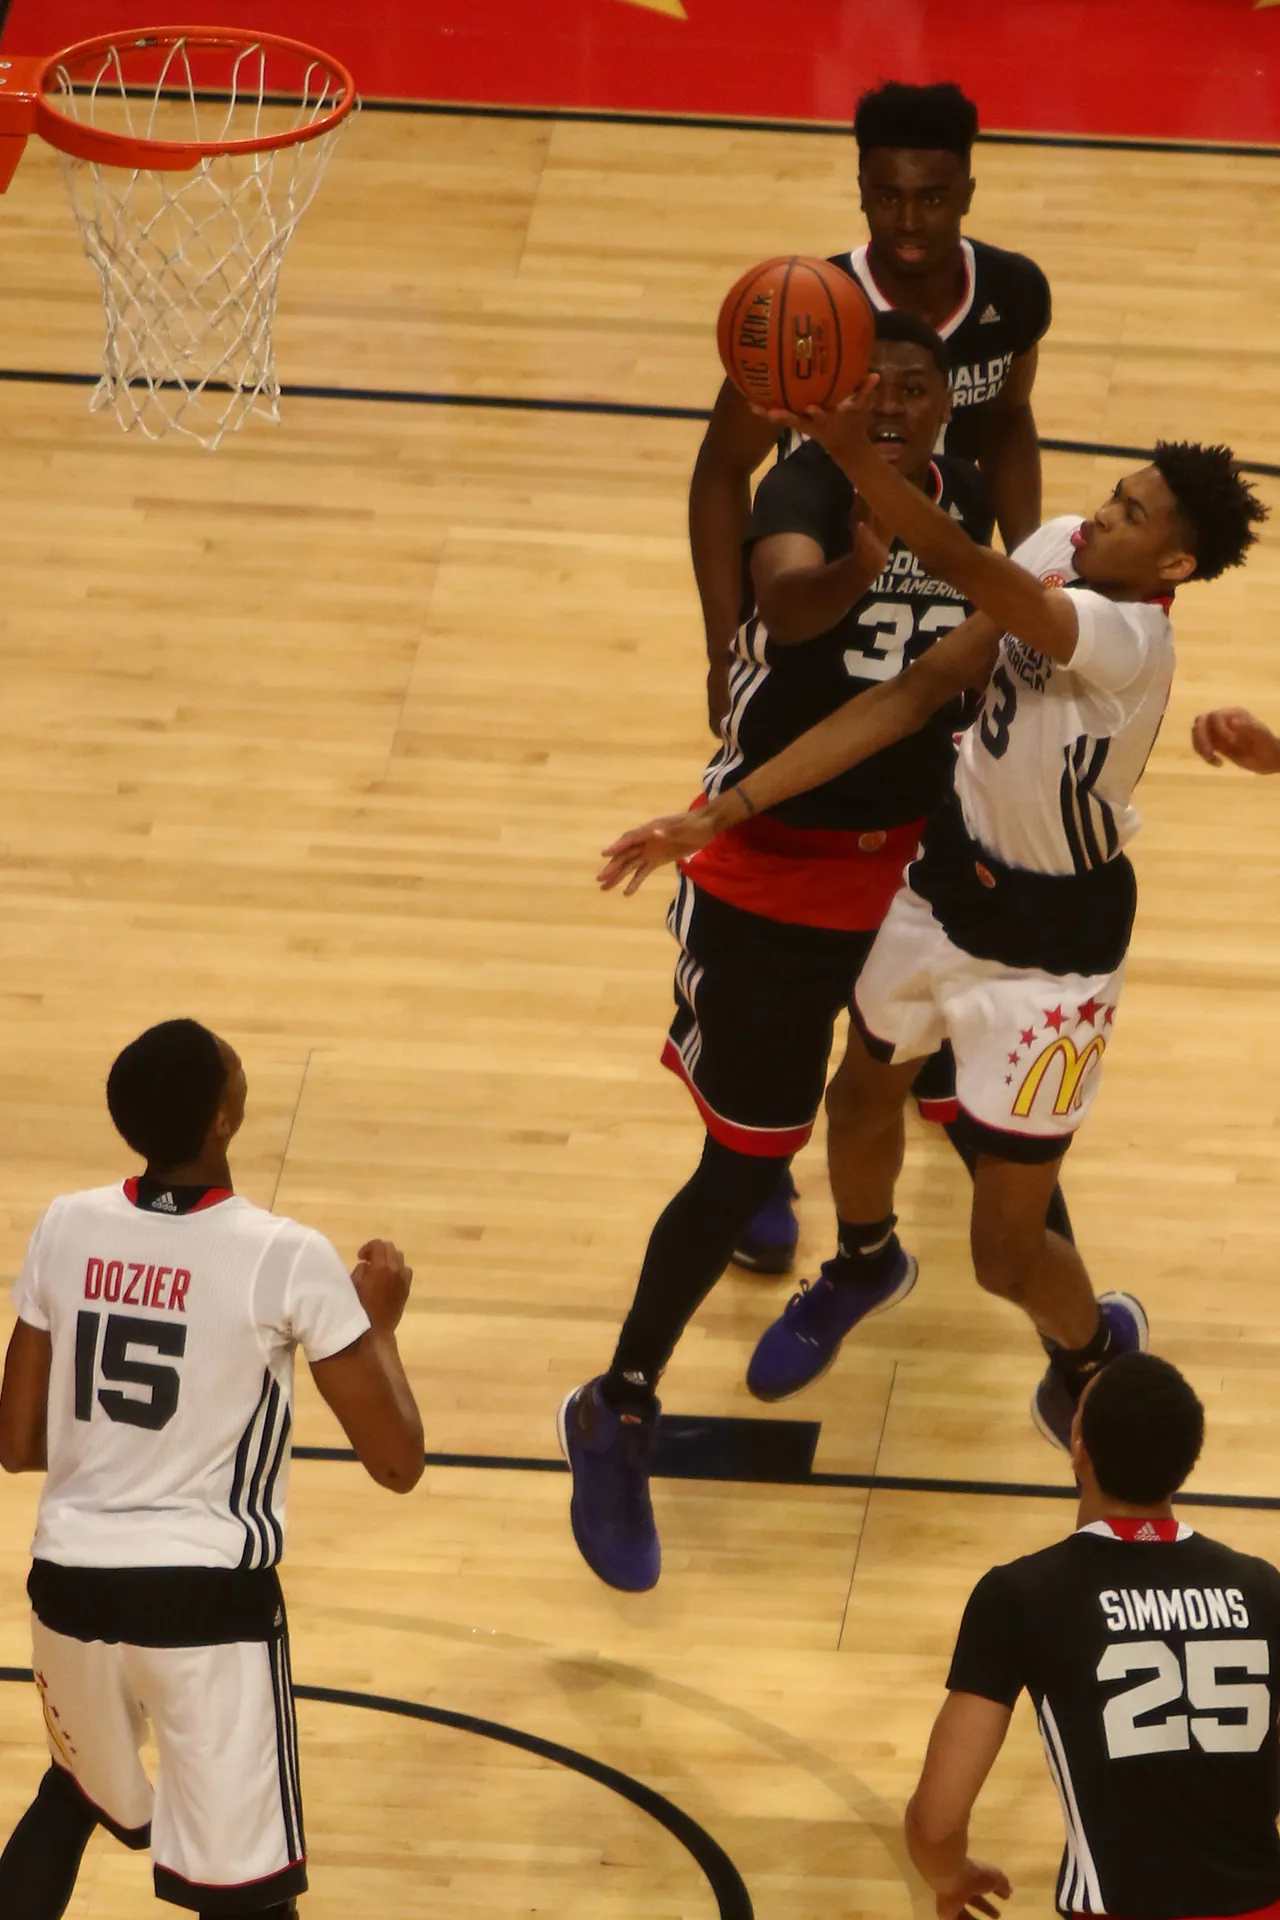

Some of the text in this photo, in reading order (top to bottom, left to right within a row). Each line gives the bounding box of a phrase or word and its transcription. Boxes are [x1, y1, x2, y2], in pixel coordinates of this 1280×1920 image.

[151, 1200, 177, 1213] adidas
[84, 1257, 191, 1312] DOZIER
[74, 1310, 188, 1431] 15
[1099, 1588, 1250, 1632] SIMMONS
[1096, 1639, 1271, 1760] 25
